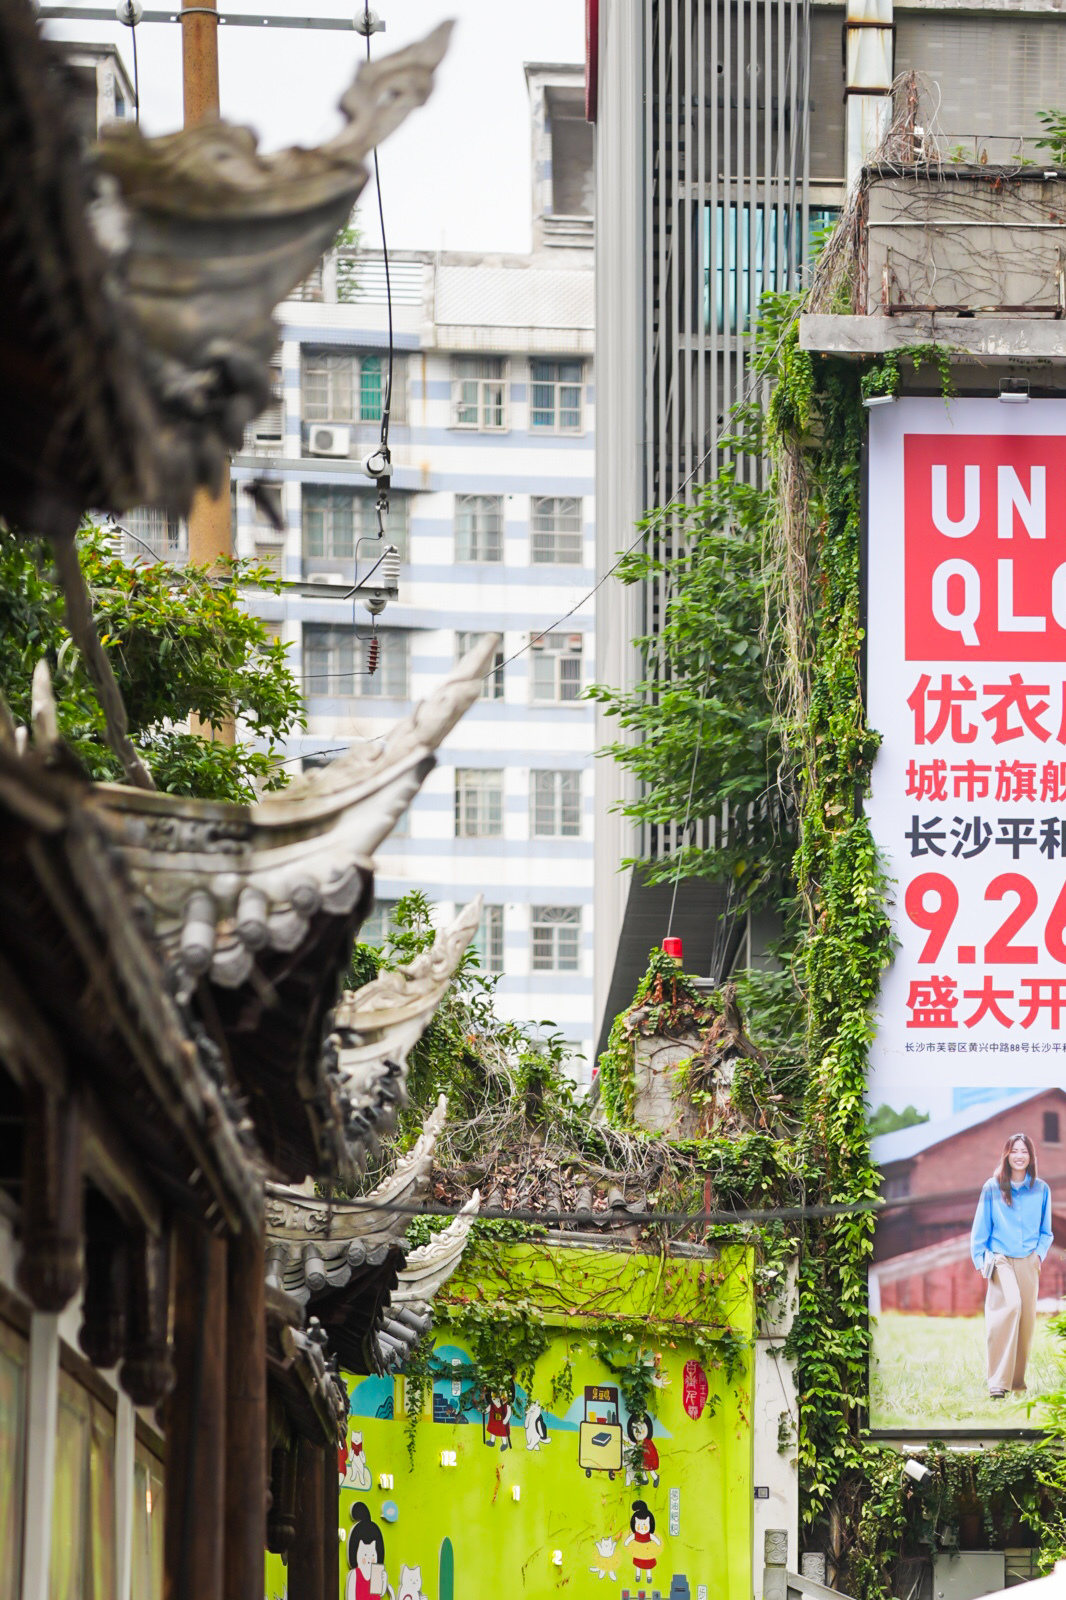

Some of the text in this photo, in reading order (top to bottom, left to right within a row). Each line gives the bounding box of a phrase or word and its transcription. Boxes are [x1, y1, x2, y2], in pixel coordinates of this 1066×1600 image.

[440, 1450, 457, 1467] 12
[379, 1473, 394, 1490] 11
[512, 1485, 520, 1501] 1
[551, 1550, 562, 1565] 2
